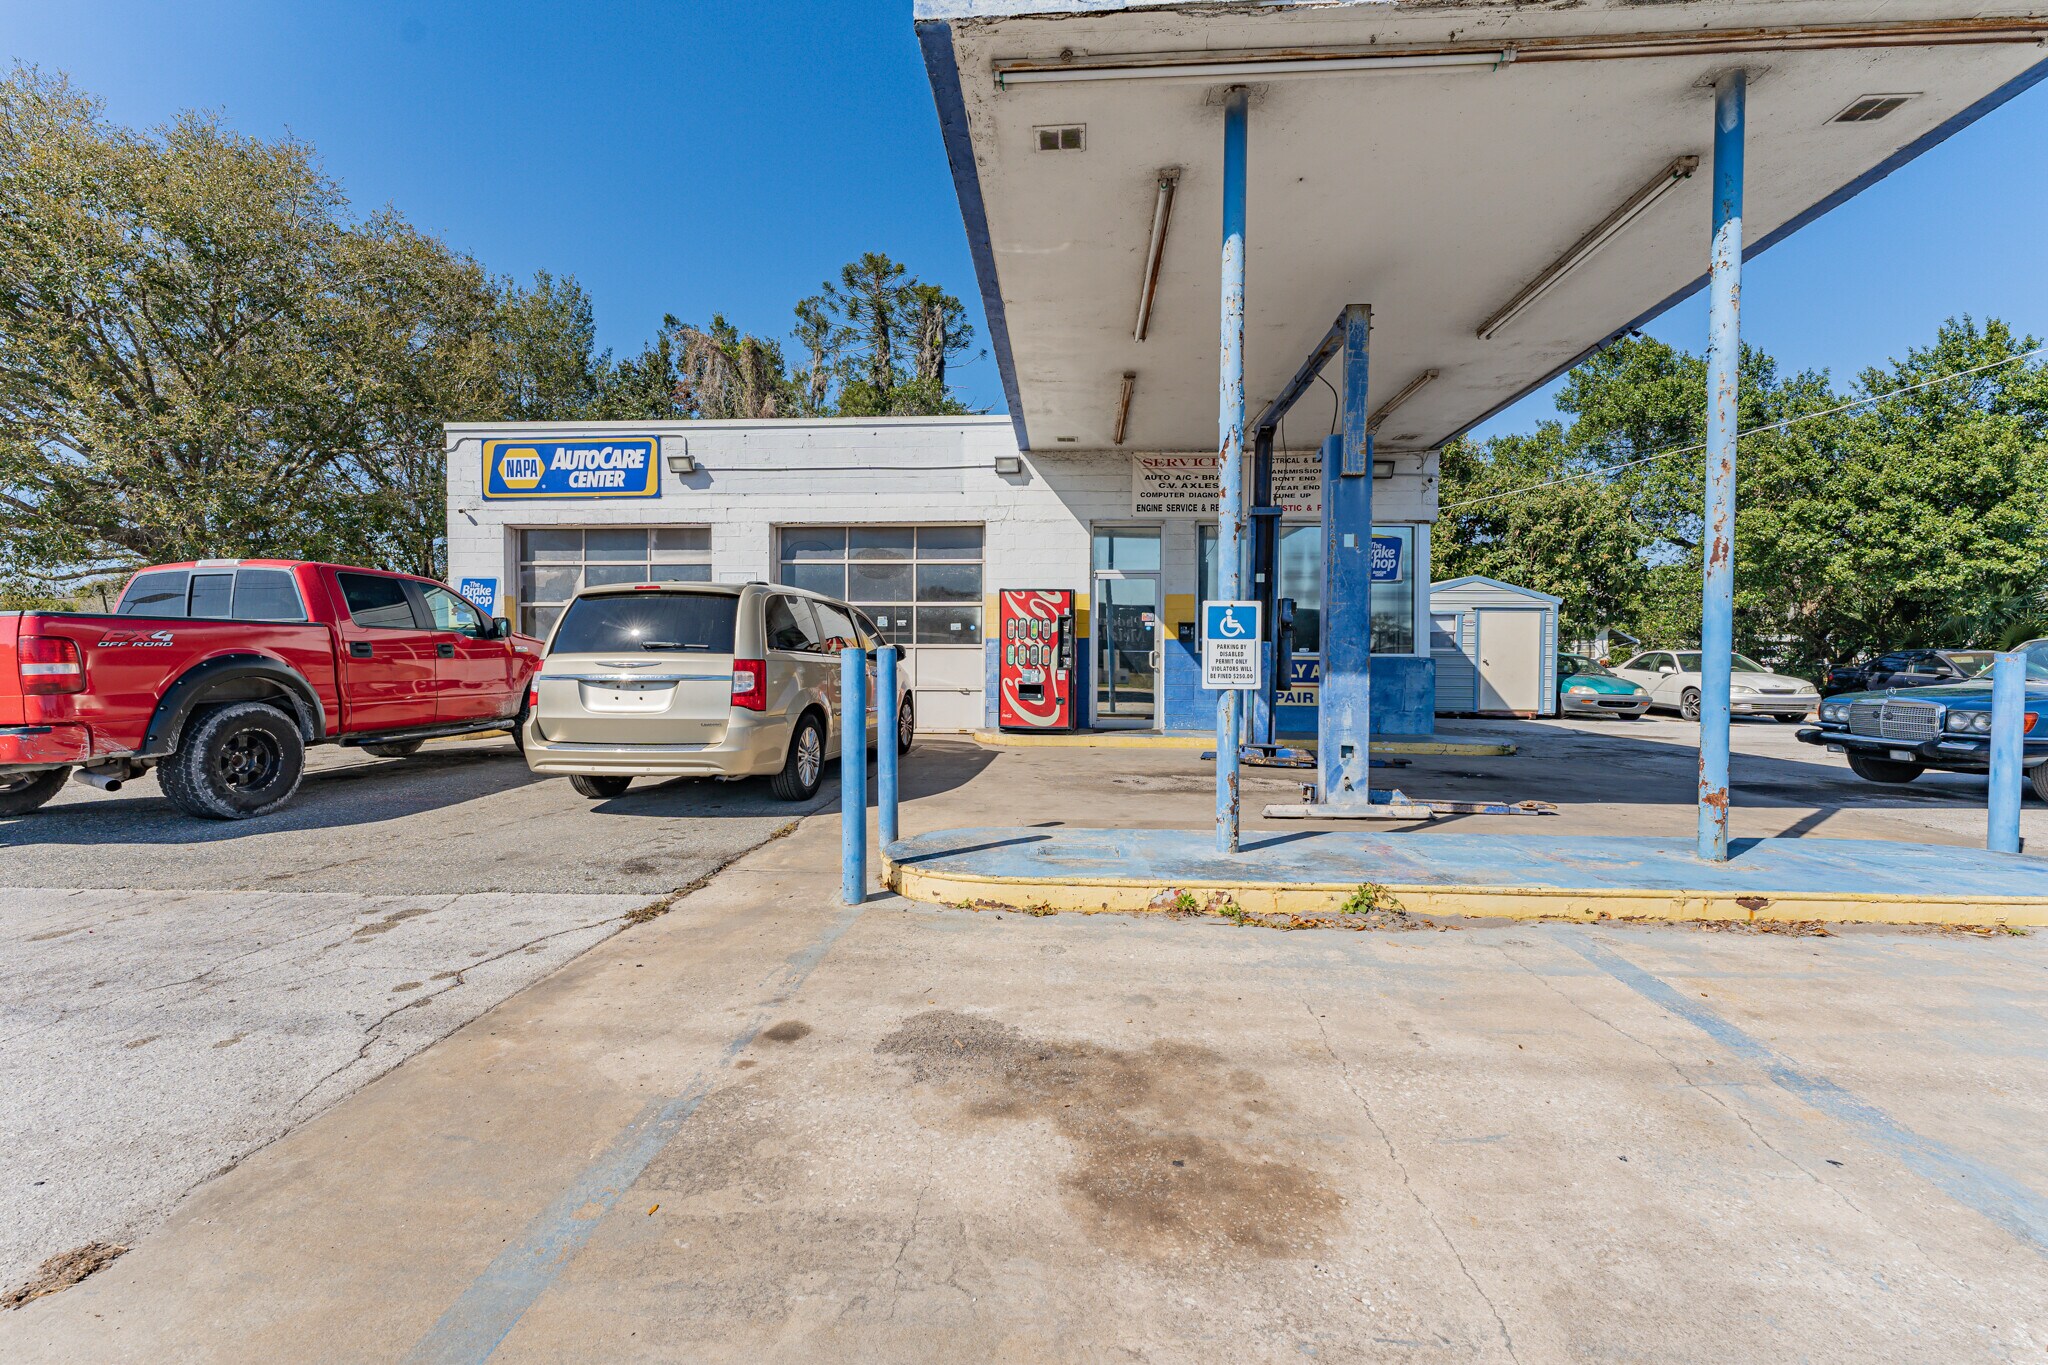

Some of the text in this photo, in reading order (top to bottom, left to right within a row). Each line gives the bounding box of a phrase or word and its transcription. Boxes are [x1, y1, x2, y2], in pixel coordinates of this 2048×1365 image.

[506, 459, 538, 478] NAPA
[568, 471, 626, 488] CENTER
[1136, 504, 1162, 512] ENGINE
[1166, 504, 1198, 512] SERVICE
[1371, 546, 1396, 558] rake
[1371, 557, 1396, 572] hop
[462, 584, 492, 596] Brake
[101, 630, 174, 642] FX4
[1276, 692, 1314, 703] PAIR
